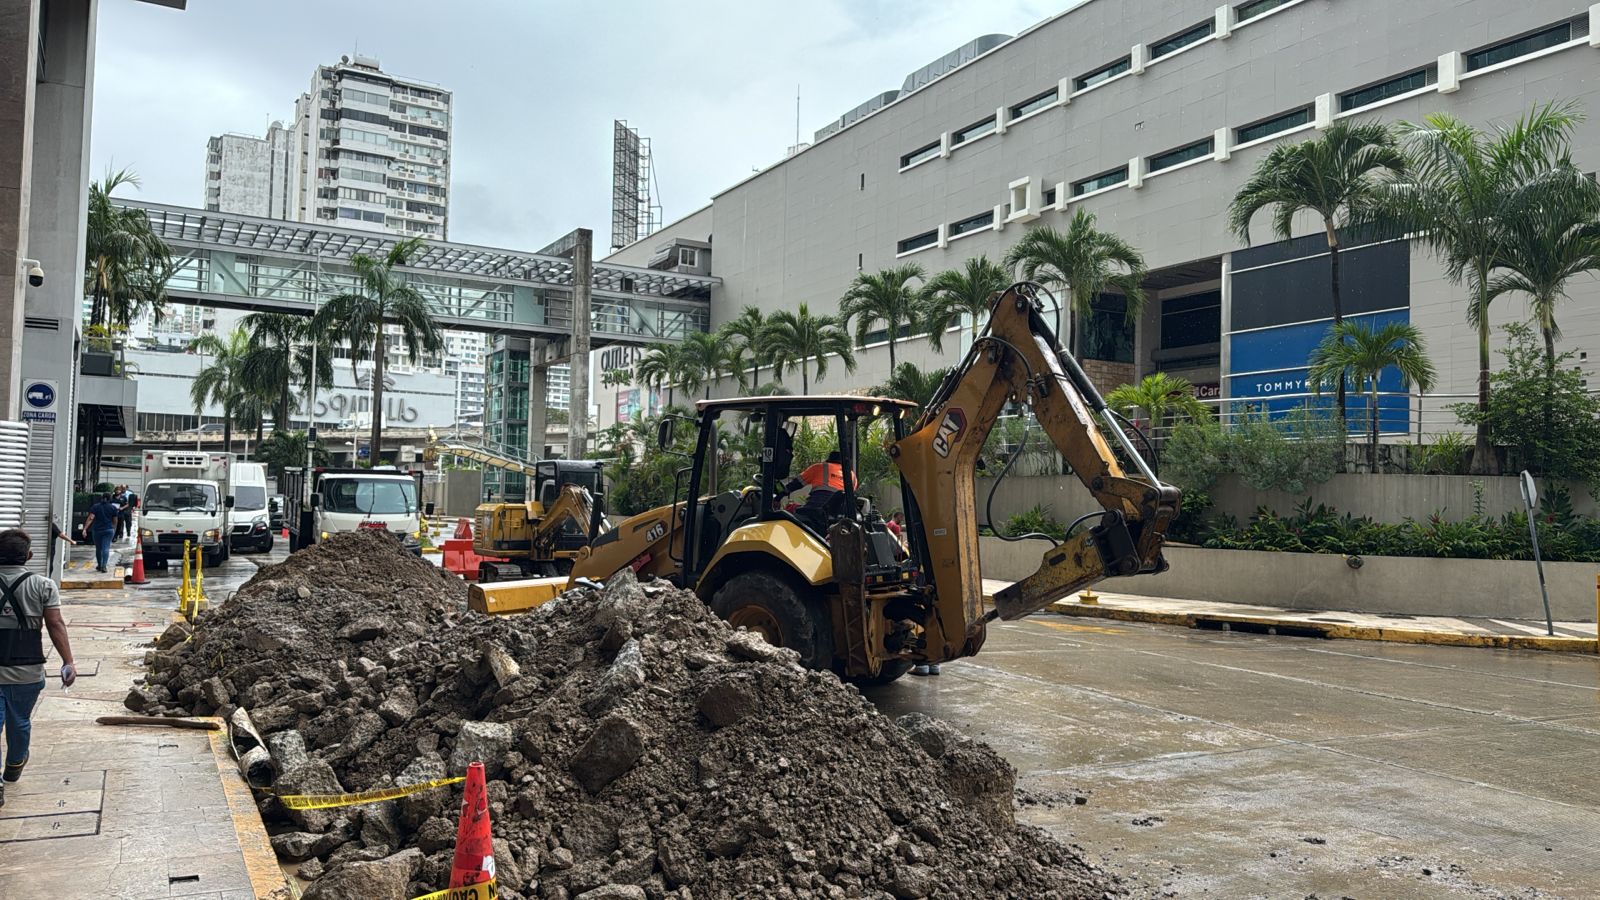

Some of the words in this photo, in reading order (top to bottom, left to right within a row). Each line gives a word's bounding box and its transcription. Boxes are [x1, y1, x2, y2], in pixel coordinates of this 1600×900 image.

[1200, 385, 1220, 397] Car
[1256, 380, 1302, 392] TOMMY
[932, 413, 960, 457] CAT
[646, 523, 664, 542] 416
